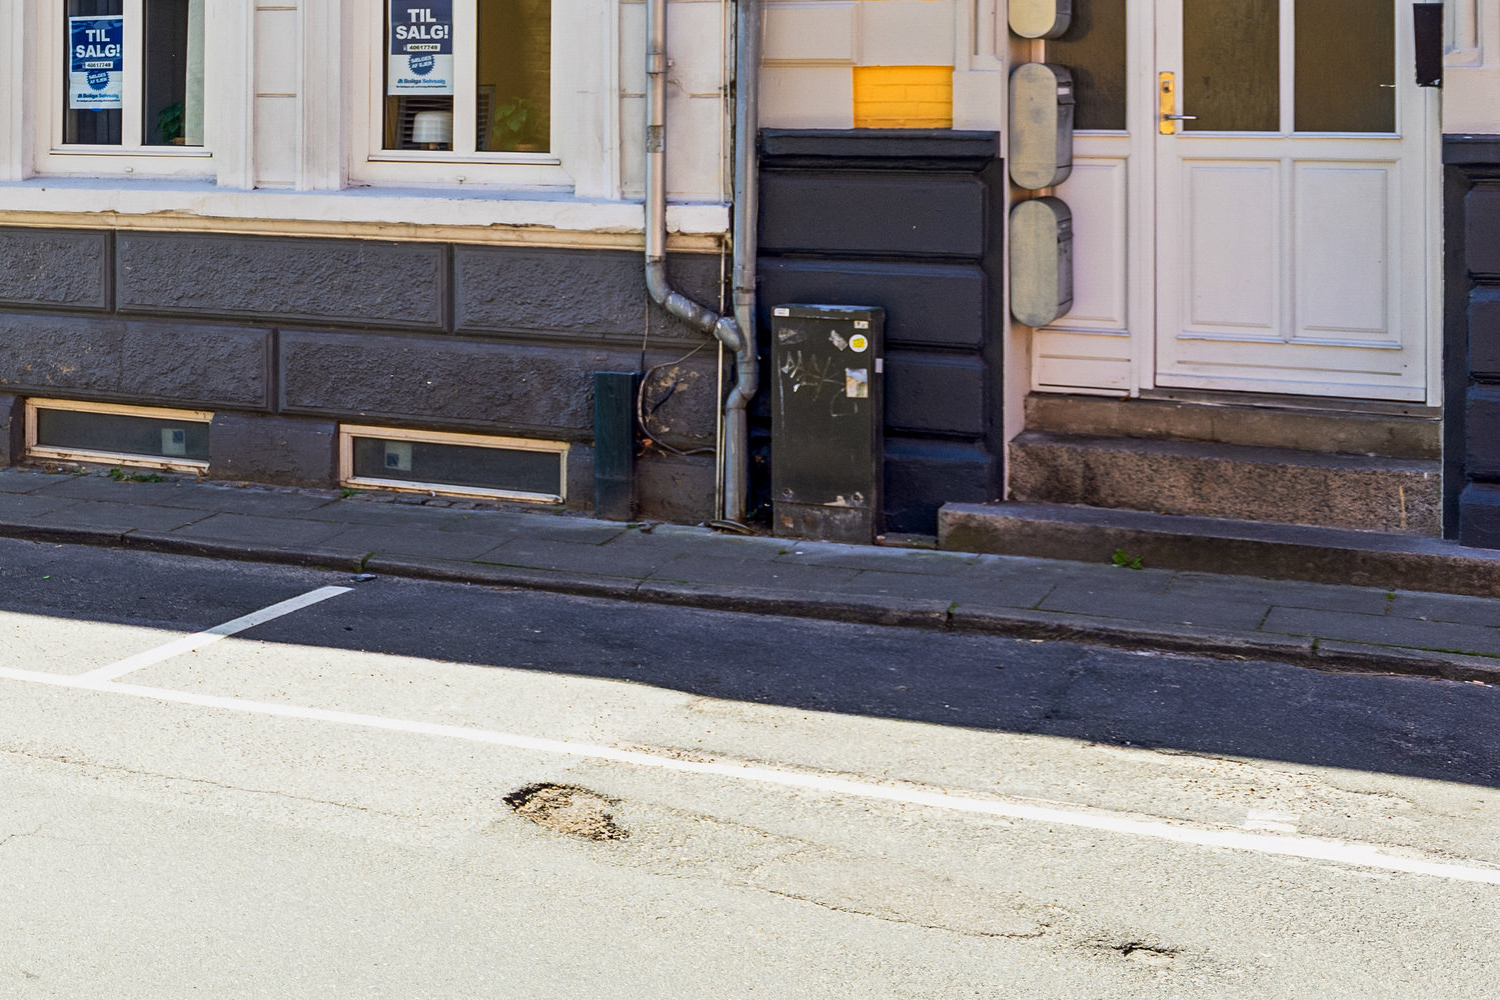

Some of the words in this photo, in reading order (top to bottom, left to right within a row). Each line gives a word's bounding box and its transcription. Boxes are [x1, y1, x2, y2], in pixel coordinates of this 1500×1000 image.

[407, 8, 436, 23] TIL
[85, 29, 110, 42] TIL
[395, 25, 449, 40] SALG!
[75, 44, 120, 58] SALG!
